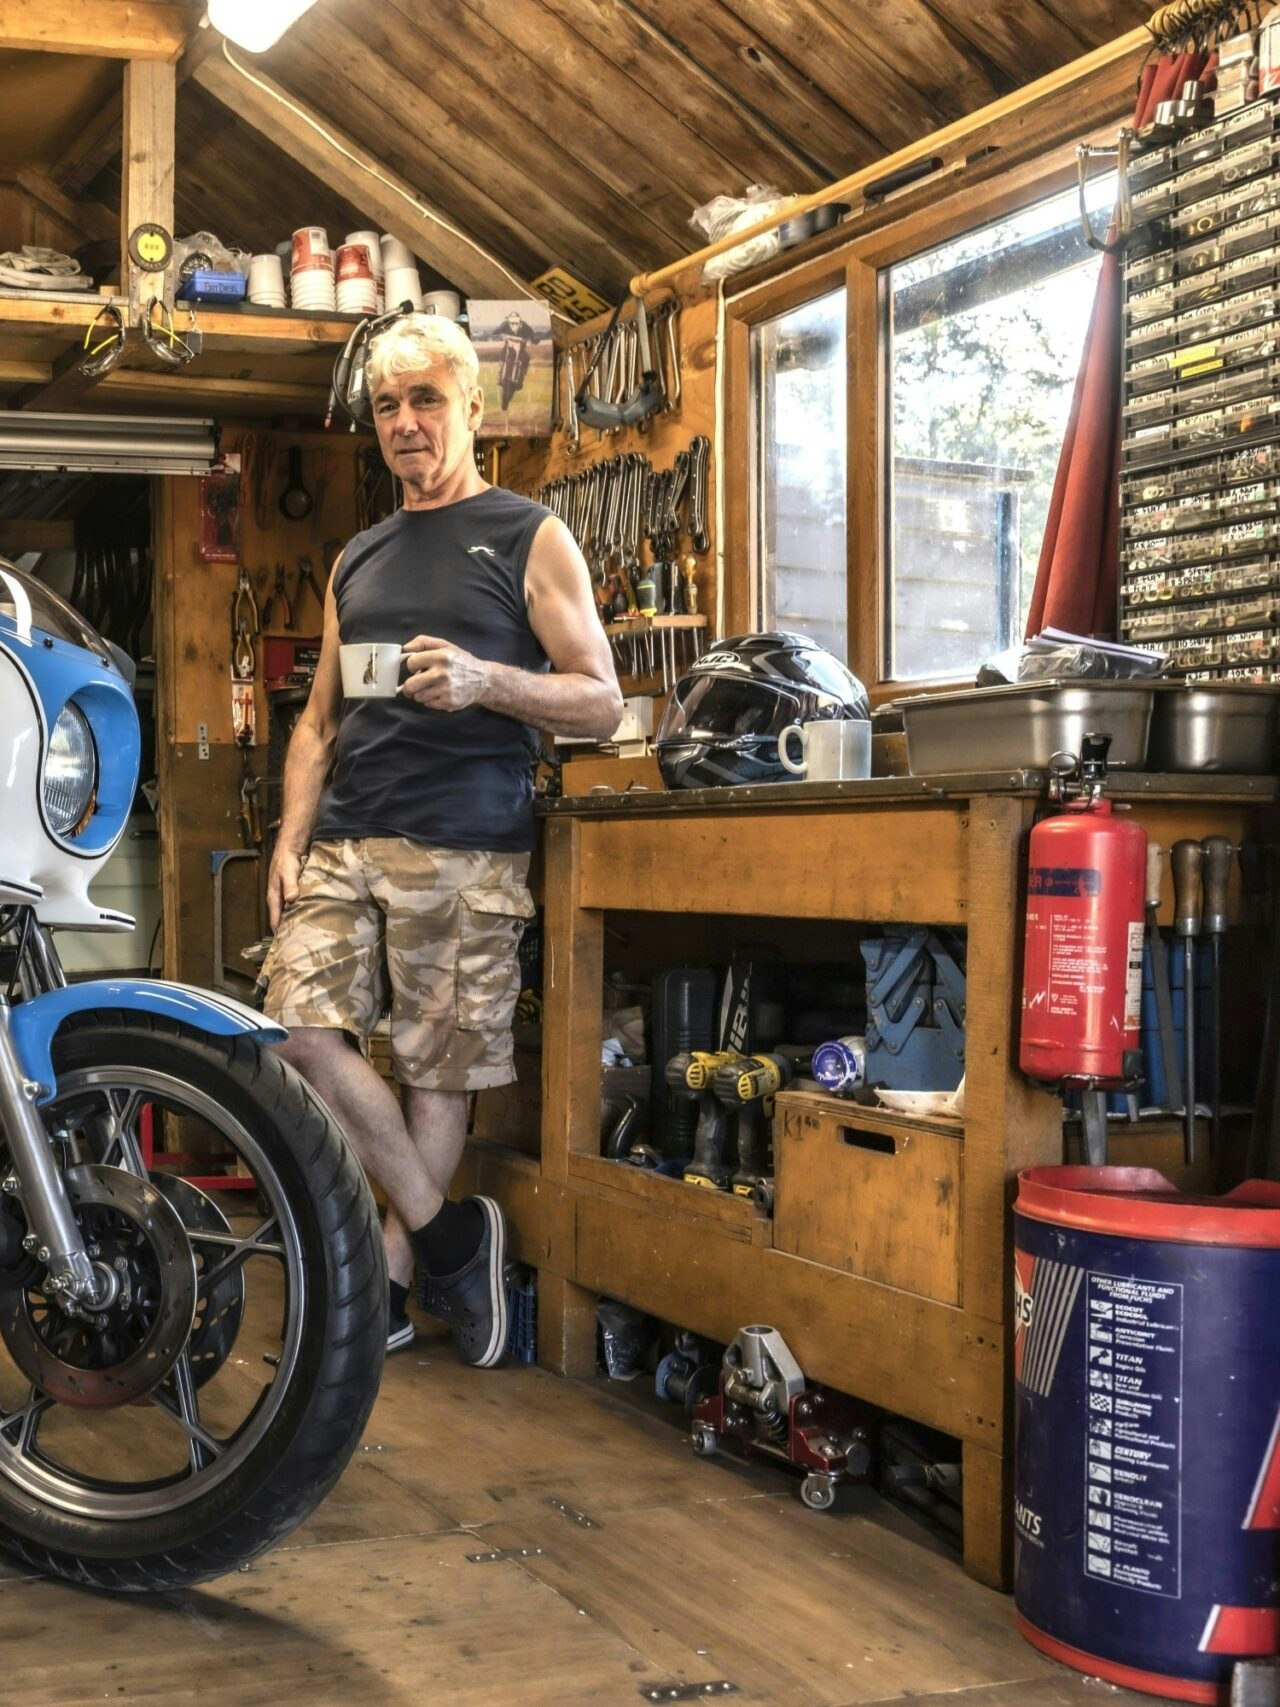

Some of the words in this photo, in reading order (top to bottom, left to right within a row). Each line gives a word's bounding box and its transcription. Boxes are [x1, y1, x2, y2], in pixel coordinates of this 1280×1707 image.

[1091, 1277, 1113, 1285] OTHER
[1113, 1279, 1156, 1292] LUBRICANTS
[1157, 1287, 1175, 1295] AND
[1097, 1284, 1139, 1296] FUNCTIONAL
[1141, 1291, 1166, 1299] FLUIDS
[1109, 1292, 1129, 1300] FROM
[1130, 1295, 1153, 1304] FUCHS
[1114, 1304, 1144, 1313] ECOCUT
[1115, 1317, 1145, 1327] Industrial
[1115, 1353, 1143, 1365] TITAN
[1114, 1362, 1134, 1371] Engine
[1134, 1366, 1146, 1374] Oils
[1115, 1374, 1143, 1386] TITAN
[1114, 1446, 1152, 1460] CENTURY
[1114, 1492, 1163, 1508] RENOCLEAN
